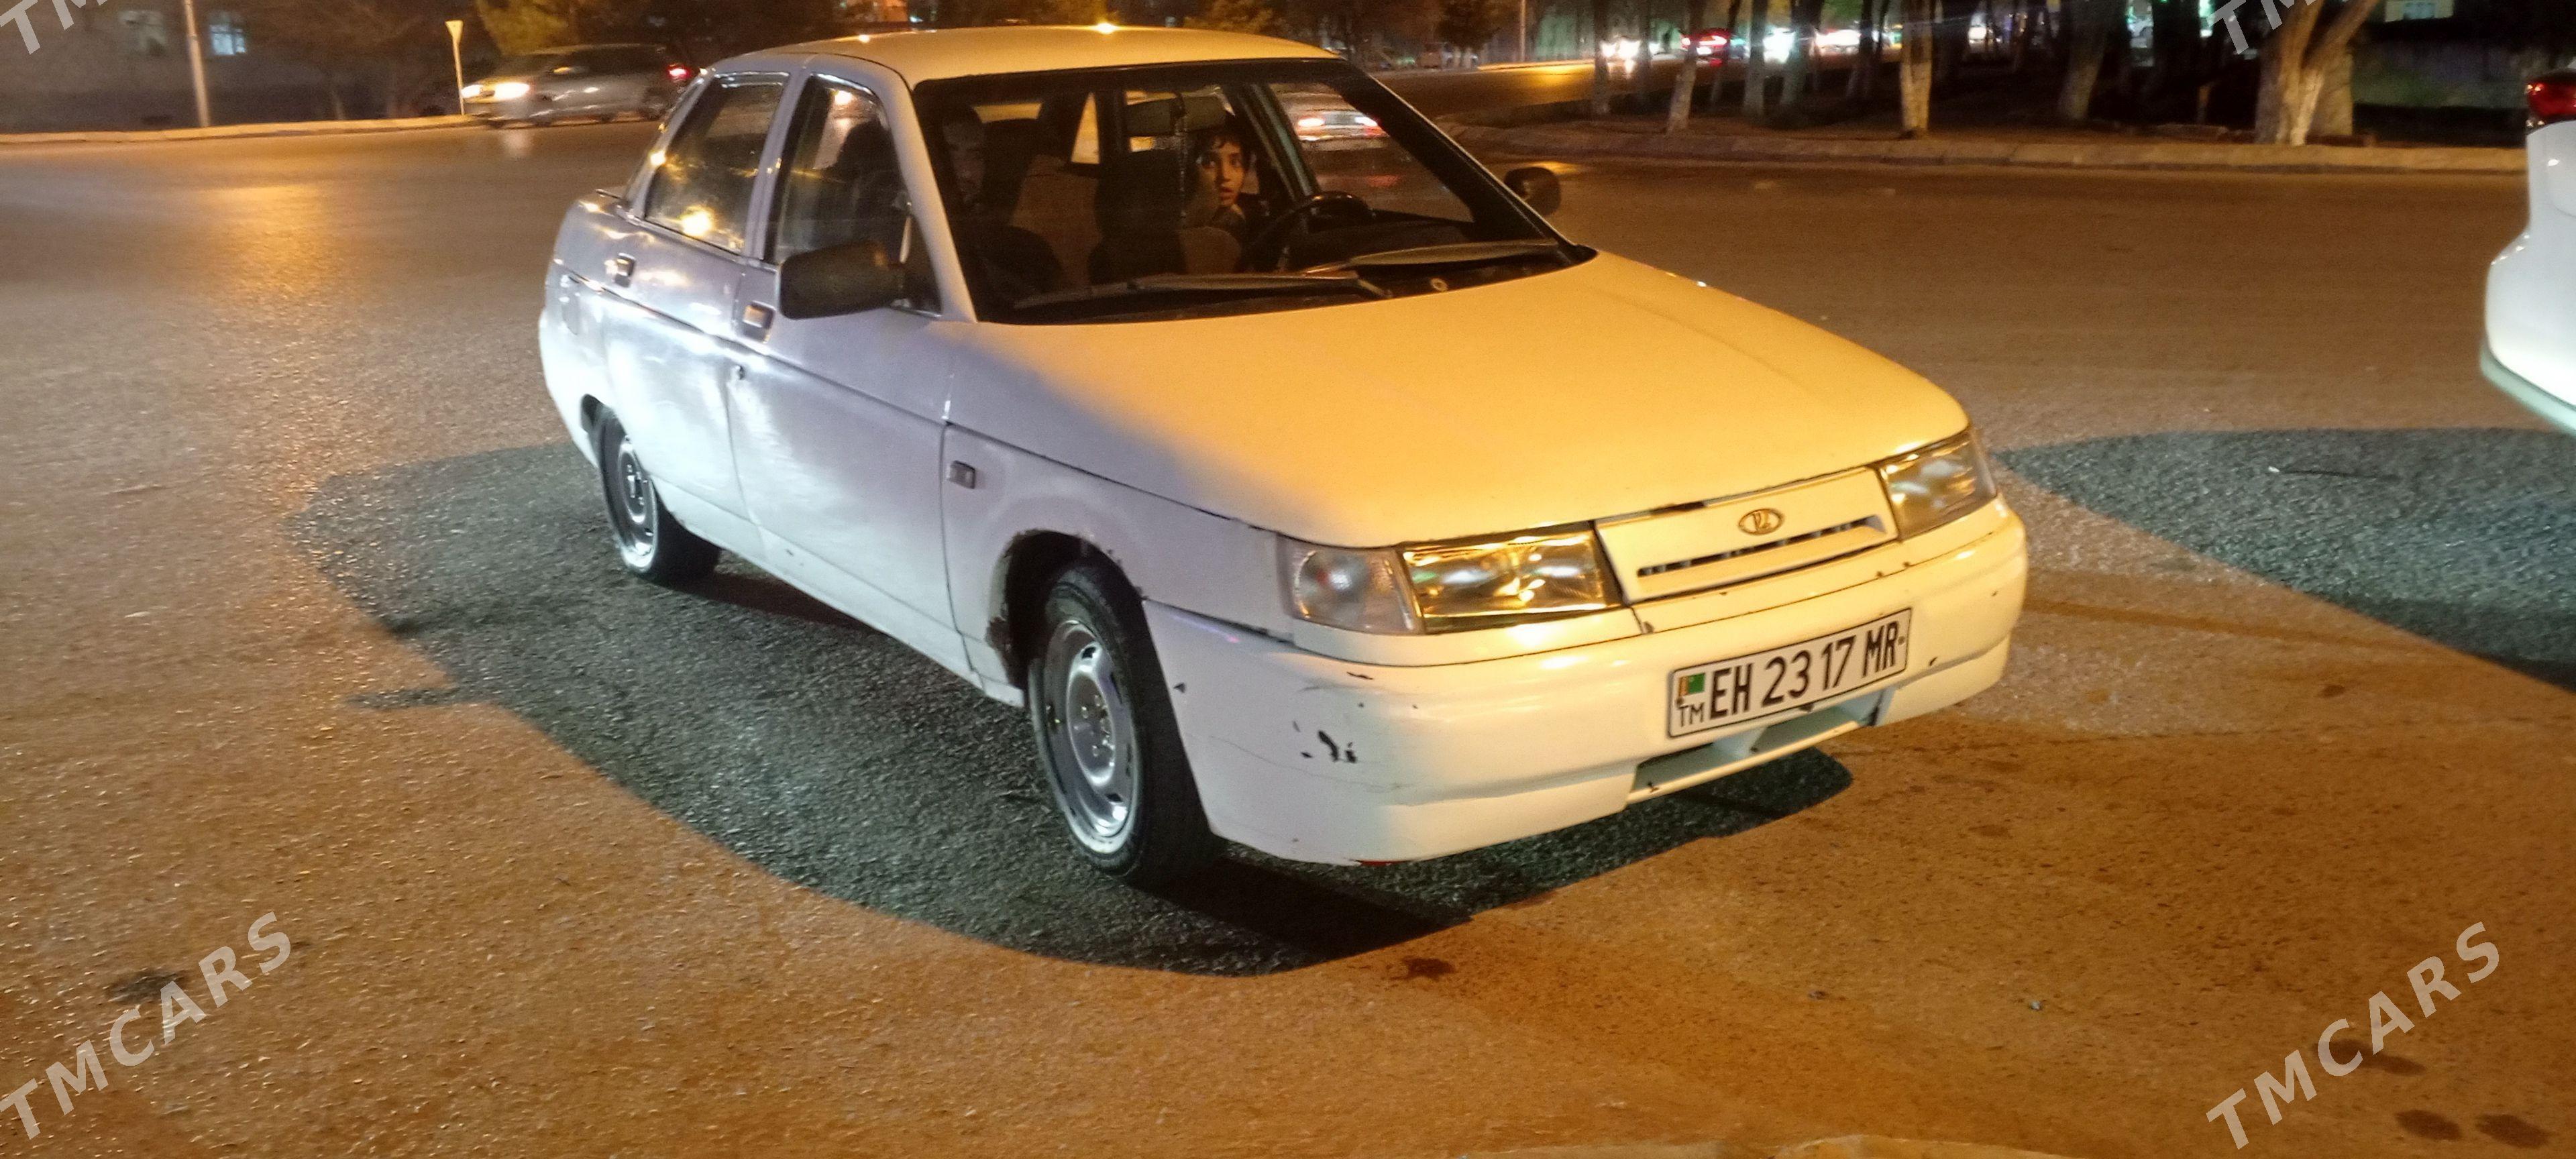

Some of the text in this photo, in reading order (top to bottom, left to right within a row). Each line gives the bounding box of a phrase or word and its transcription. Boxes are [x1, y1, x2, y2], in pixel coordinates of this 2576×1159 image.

[1710, 621, 1898, 719] EH 23 17 MR
[1678, 702, 1705, 727] TM
